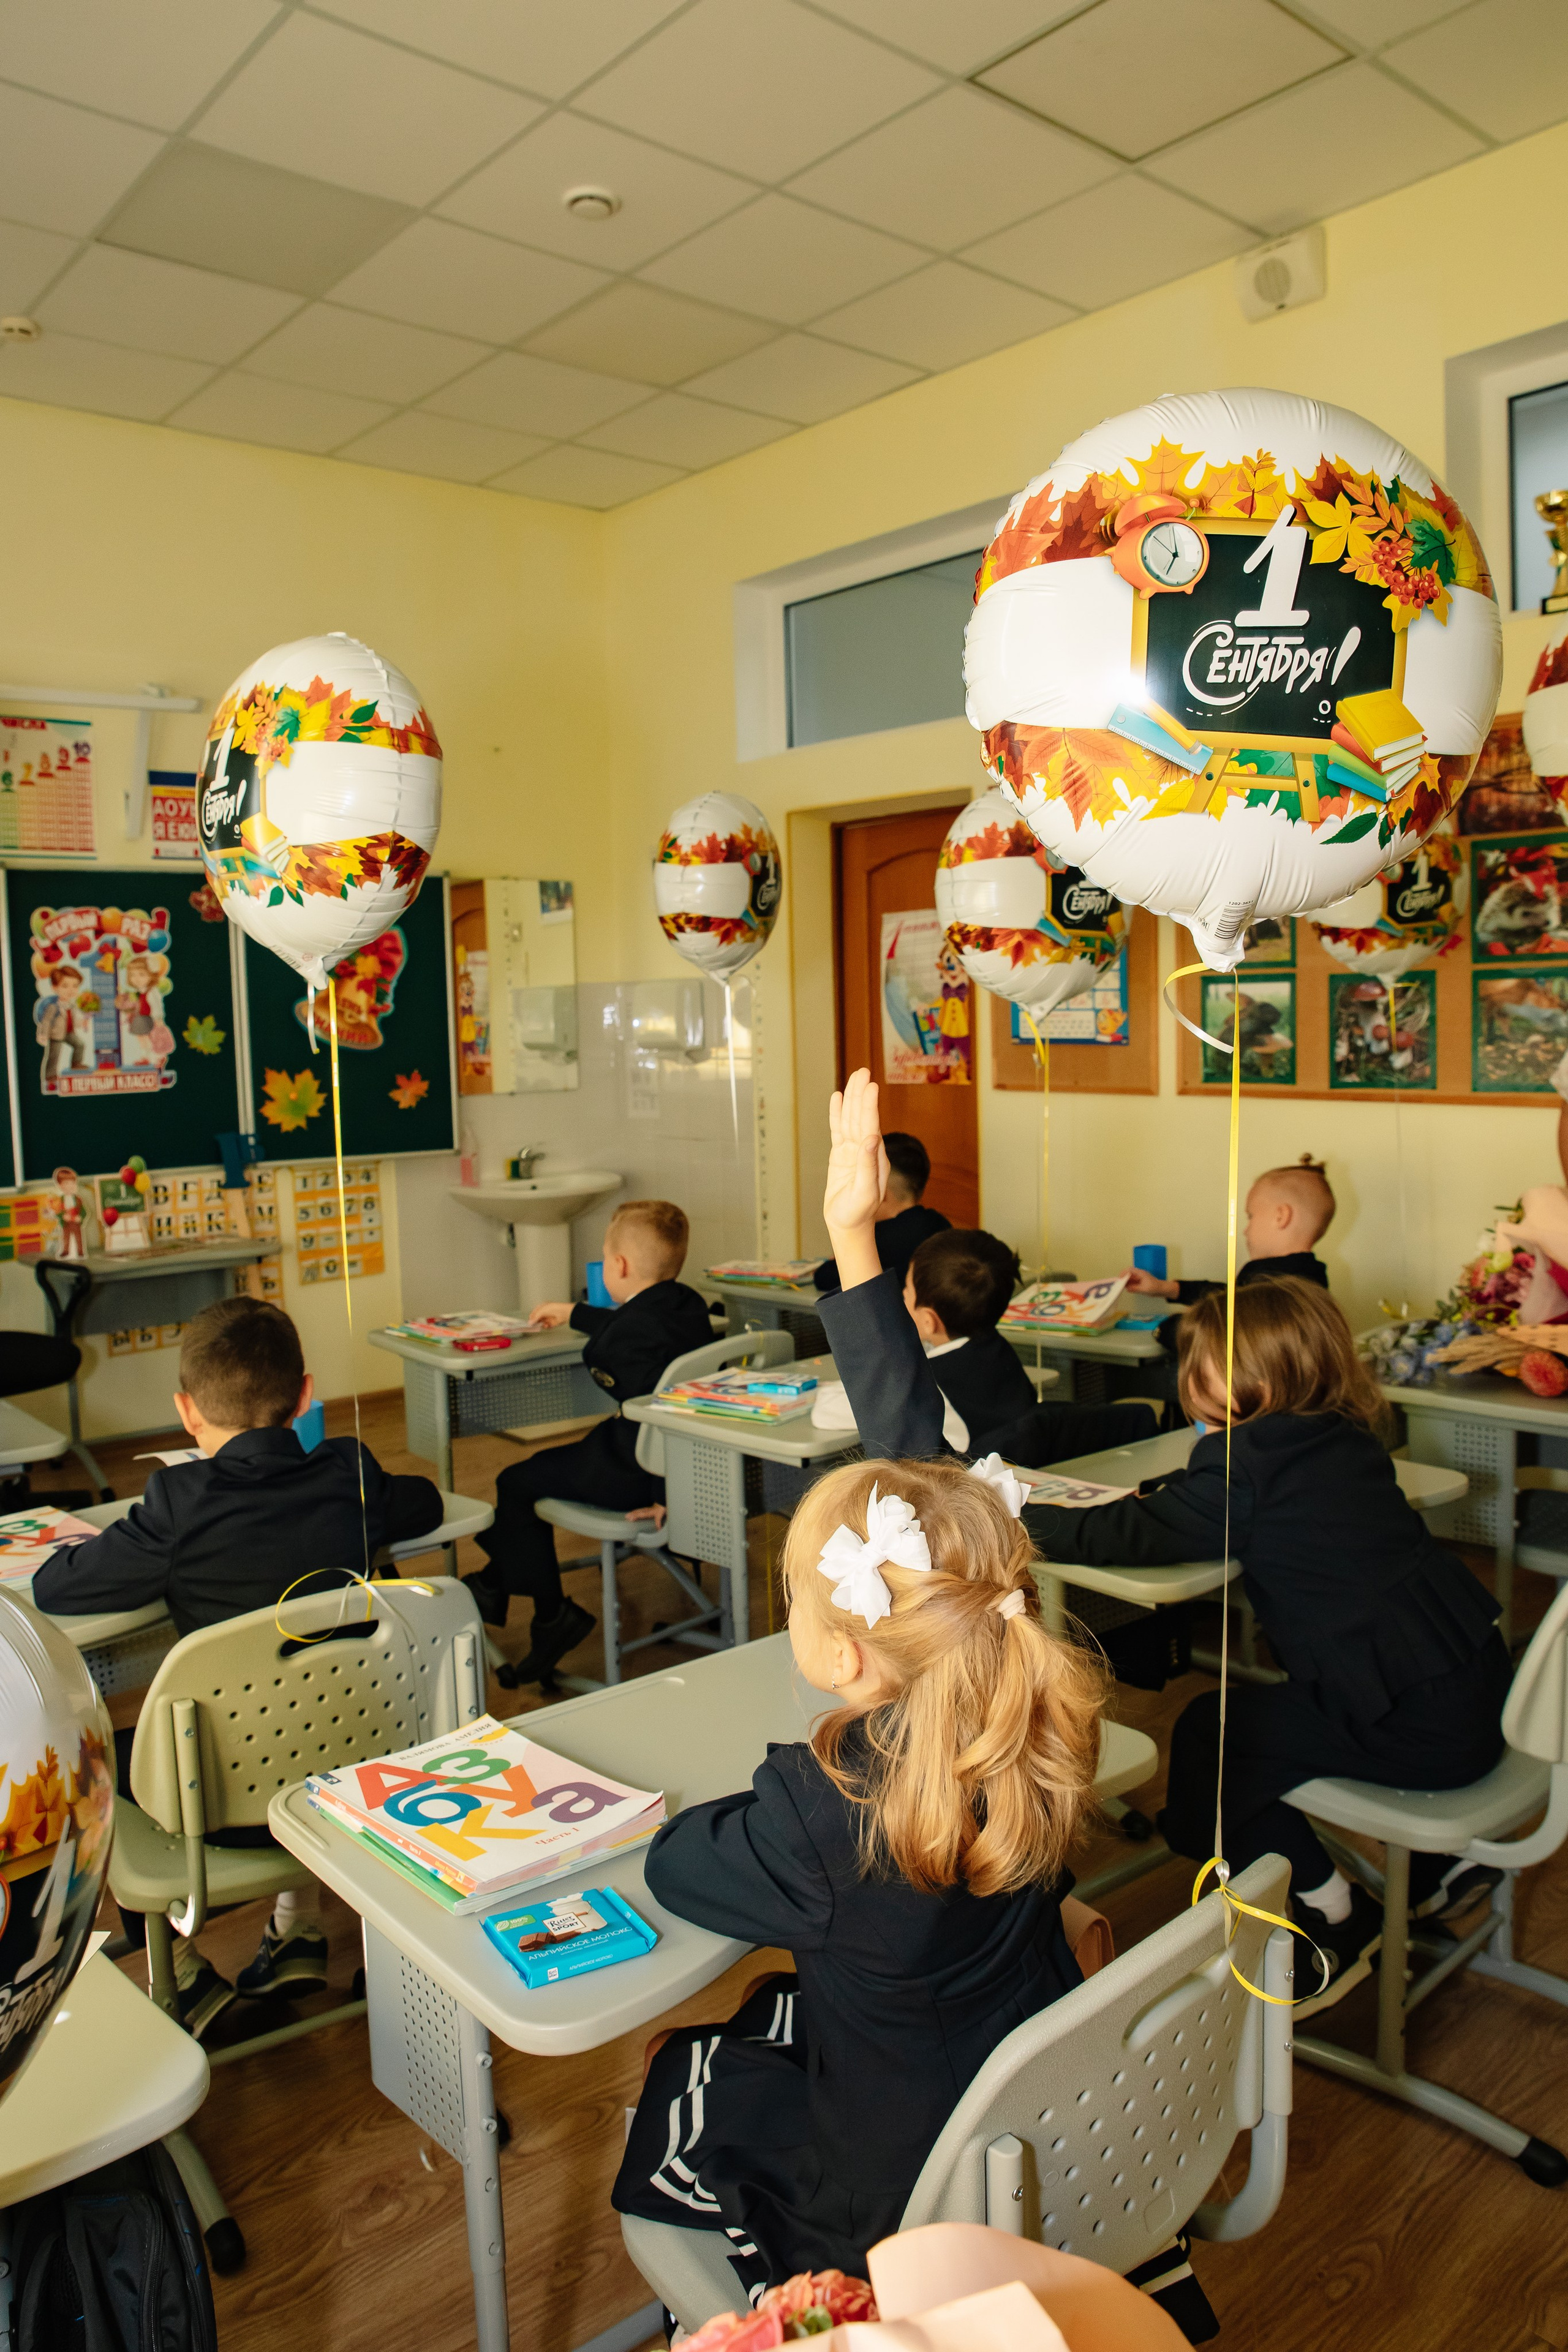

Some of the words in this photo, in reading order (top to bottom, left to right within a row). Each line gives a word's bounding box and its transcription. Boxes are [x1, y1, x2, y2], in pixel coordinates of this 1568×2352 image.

[1235, 505, 1310, 627] 1
[208, 716, 236, 792] 1
[535, 1832, 571, 1845] Часть
[547, 1915, 576, 1928] Ritter
[552, 1921, 579, 1932] SPORT
[529, 1939, 589, 1961] АЛЬПИЙСКОЕ
[591, 1926, 633, 1942] МОЛОКО
